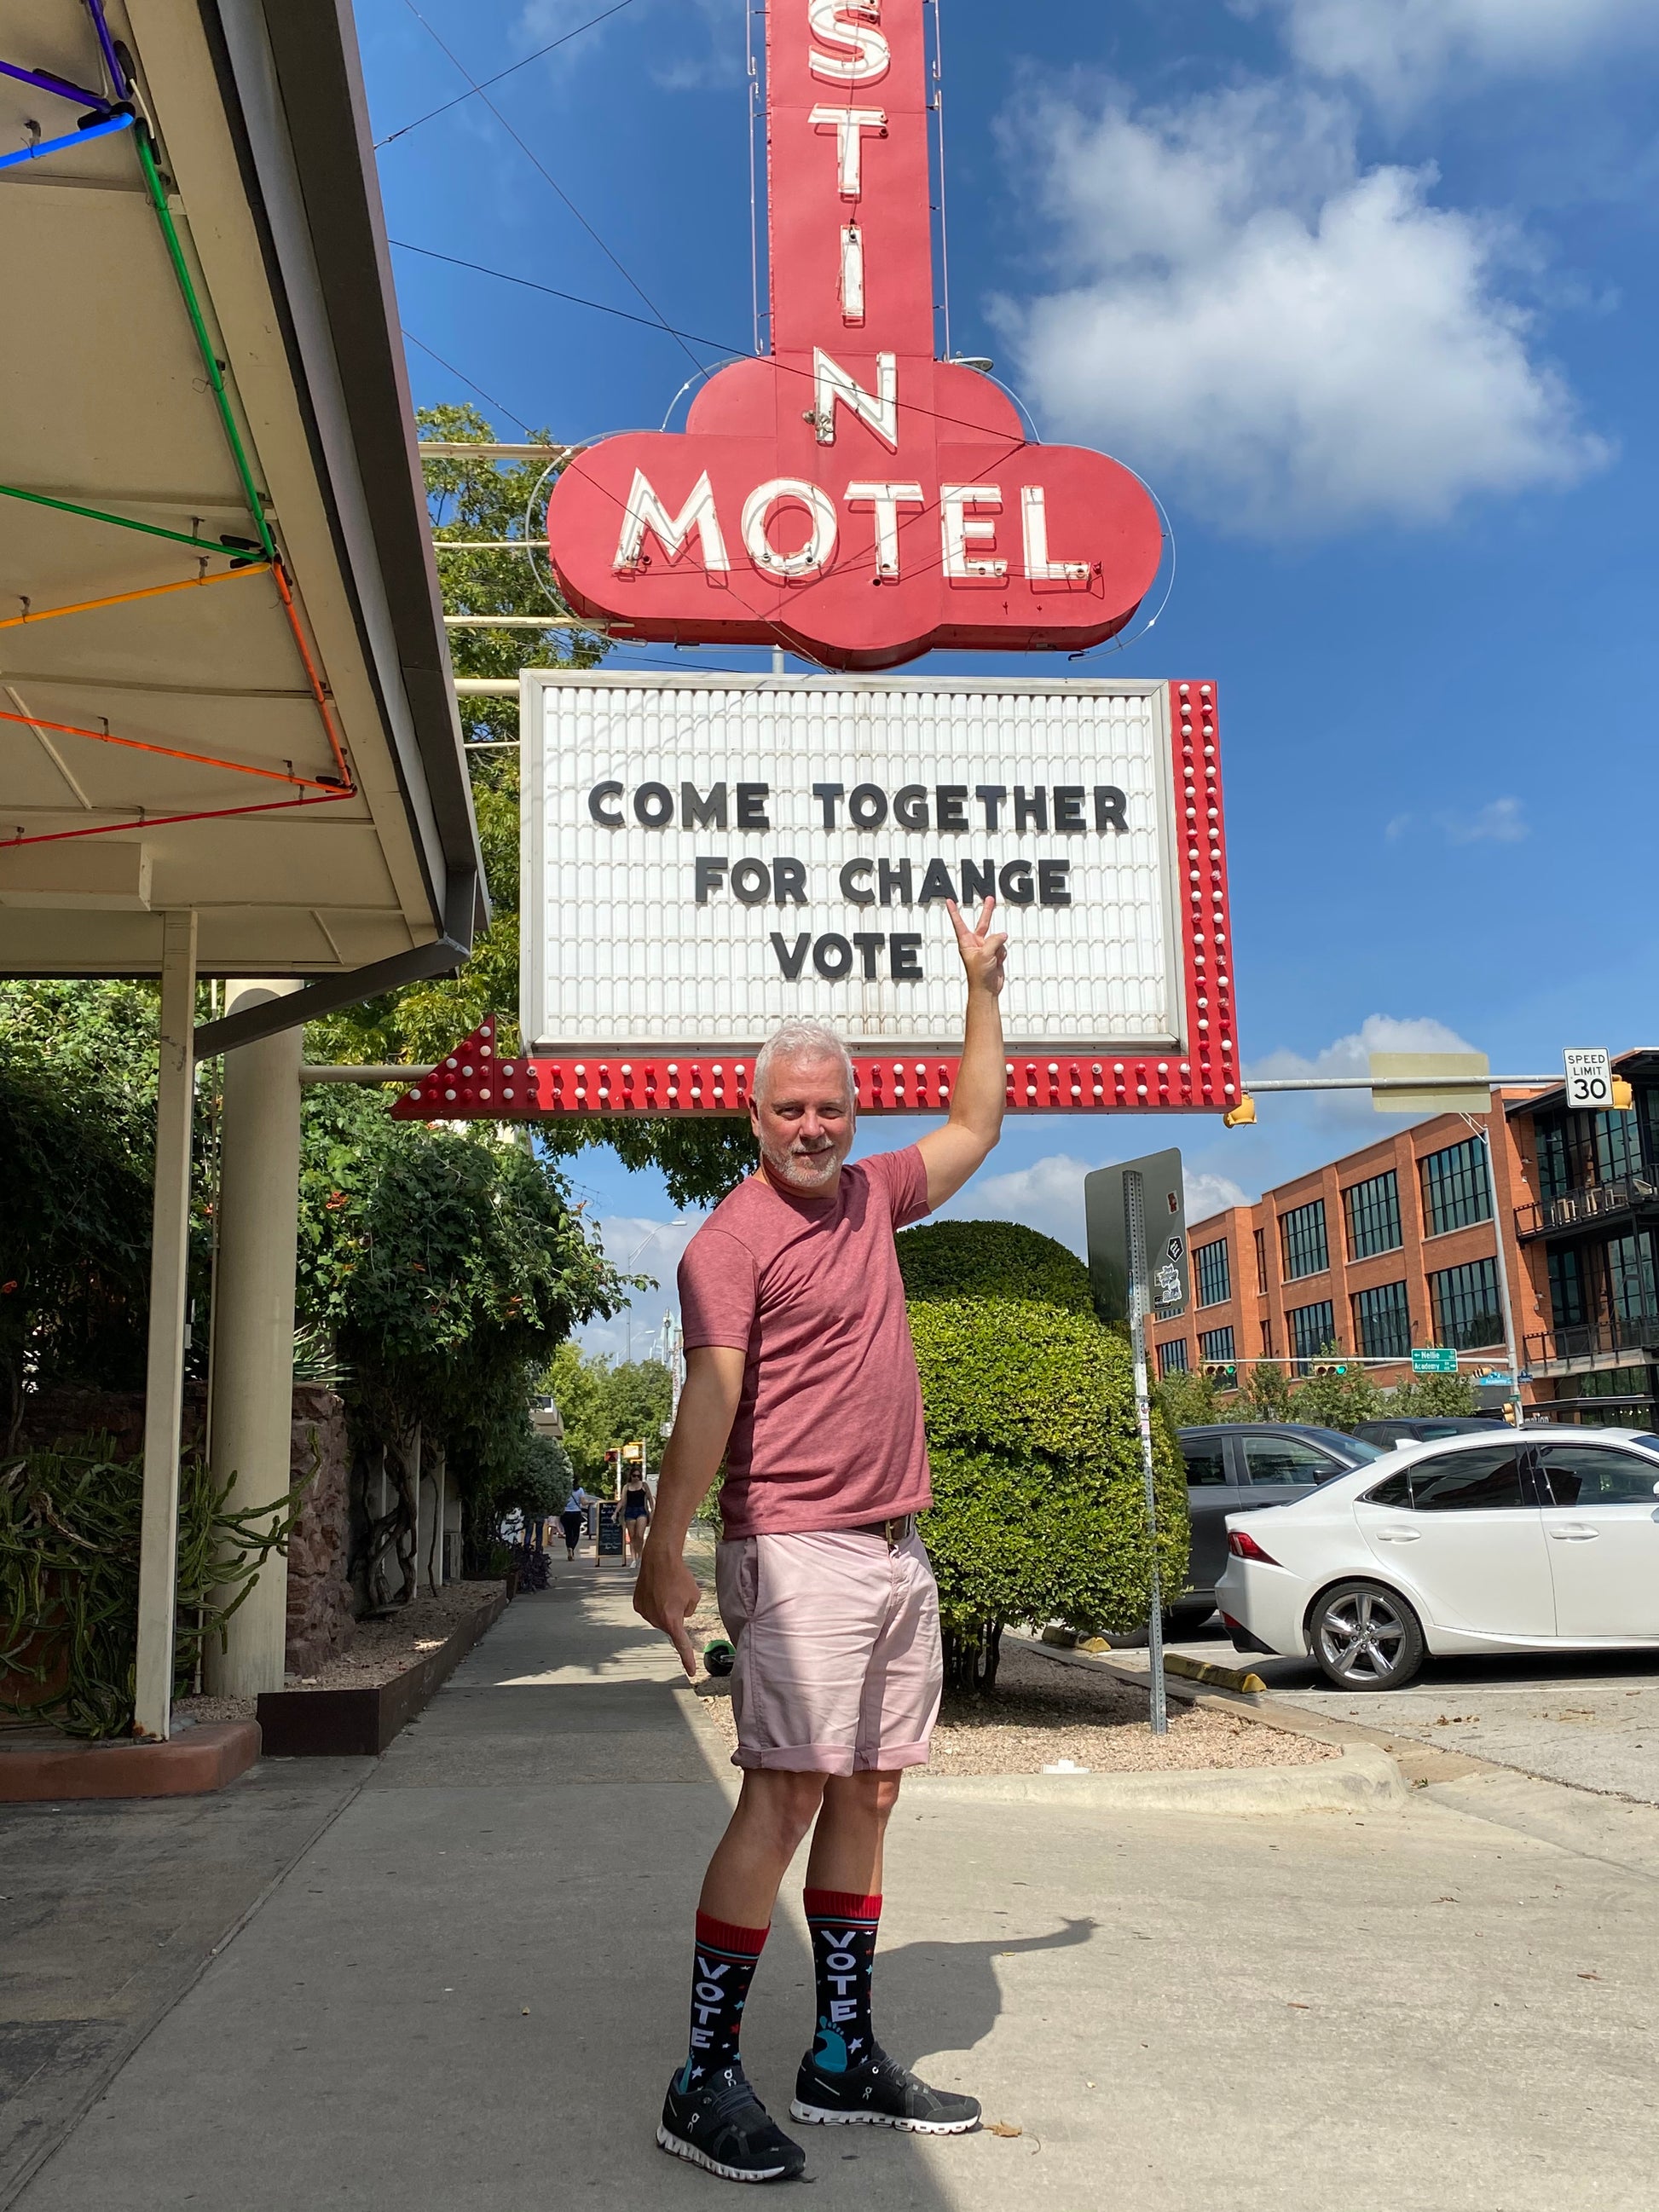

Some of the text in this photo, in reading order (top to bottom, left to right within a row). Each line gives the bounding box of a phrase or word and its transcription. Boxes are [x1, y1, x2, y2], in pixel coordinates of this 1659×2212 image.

[611, 466, 1092, 580] MOTEL
[588, 780, 1129, 833] COME TOGETHER
[695, 856, 1072, 906] FOR CHANGE
[770, 932, 923, 981] VOTE
[1568, 1054, 1605, 1065] SPEED
[1573, 1066, 1602, 1076] LIMIT
[1574, 1077, 1607, 1100] 30
[1414, 1362, 1440, 1372] Academy
[1420, 1350, 1441, 1360] Nellie
[821, 1930, 858, 2024] VOTE
[691, 1955, 731, 2049] VOTE
